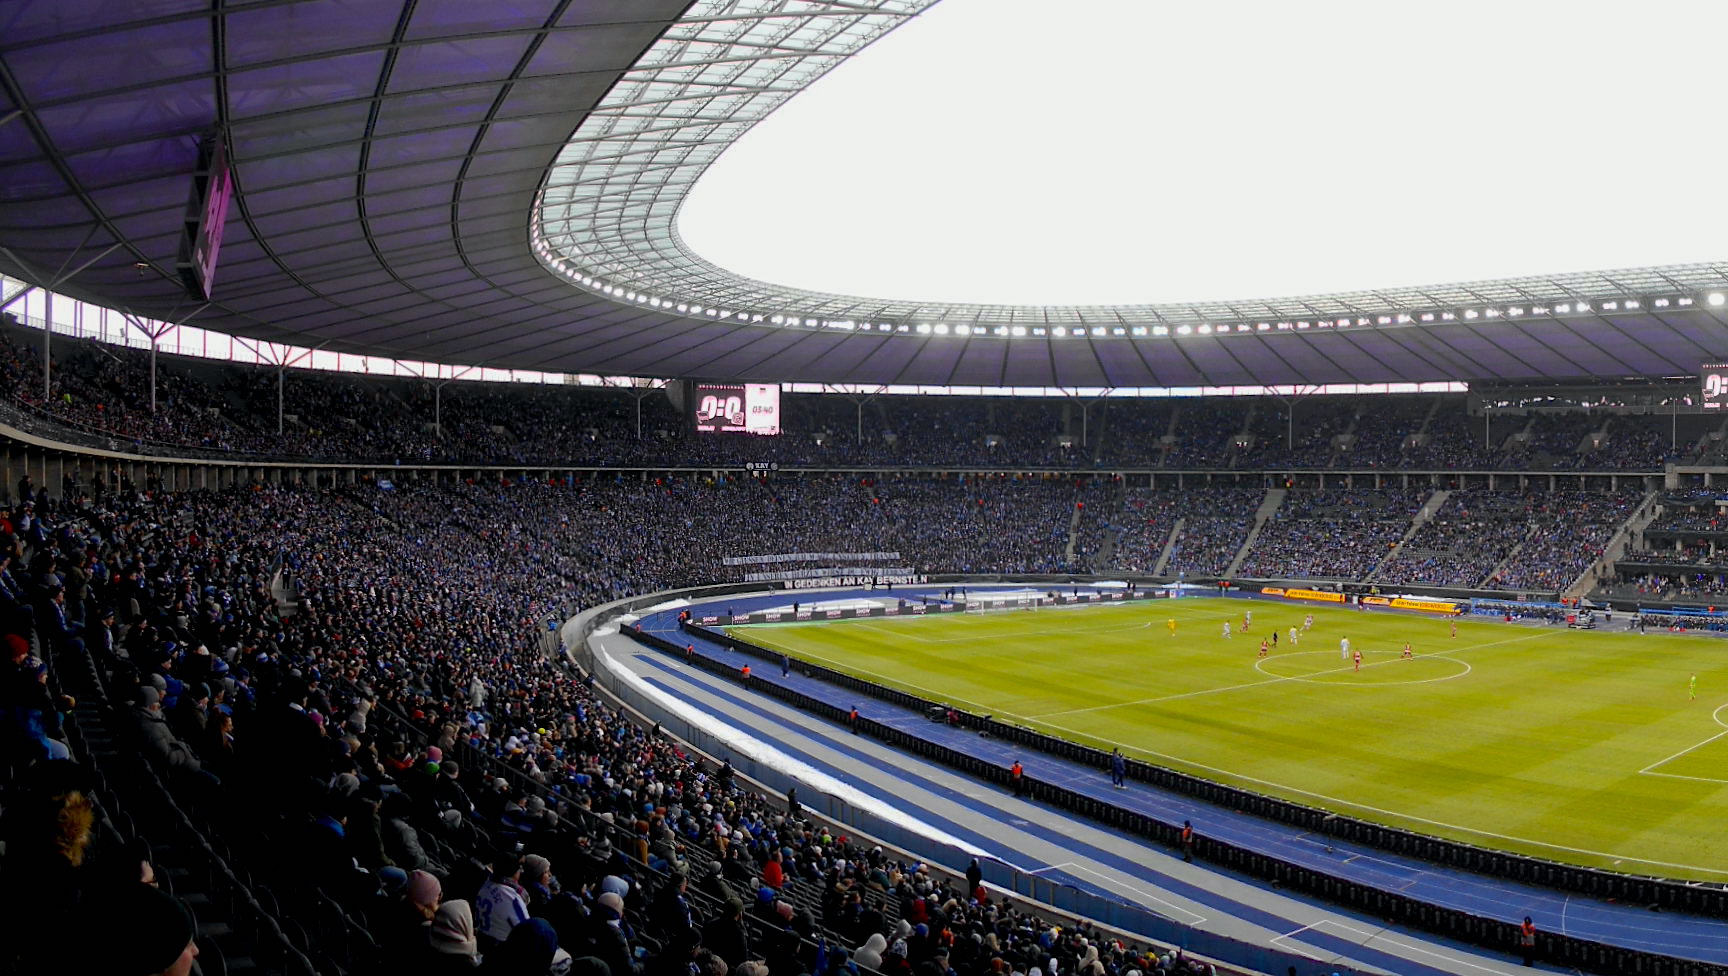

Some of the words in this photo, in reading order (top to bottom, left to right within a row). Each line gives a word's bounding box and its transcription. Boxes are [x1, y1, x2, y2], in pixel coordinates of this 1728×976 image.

[794, 577, 842, 588] GEDENKEN
[843, 577, 856, 586] AN
[857, 575, 874, 585] KAY
[877, 575, 928, 585] BERNSTEN
